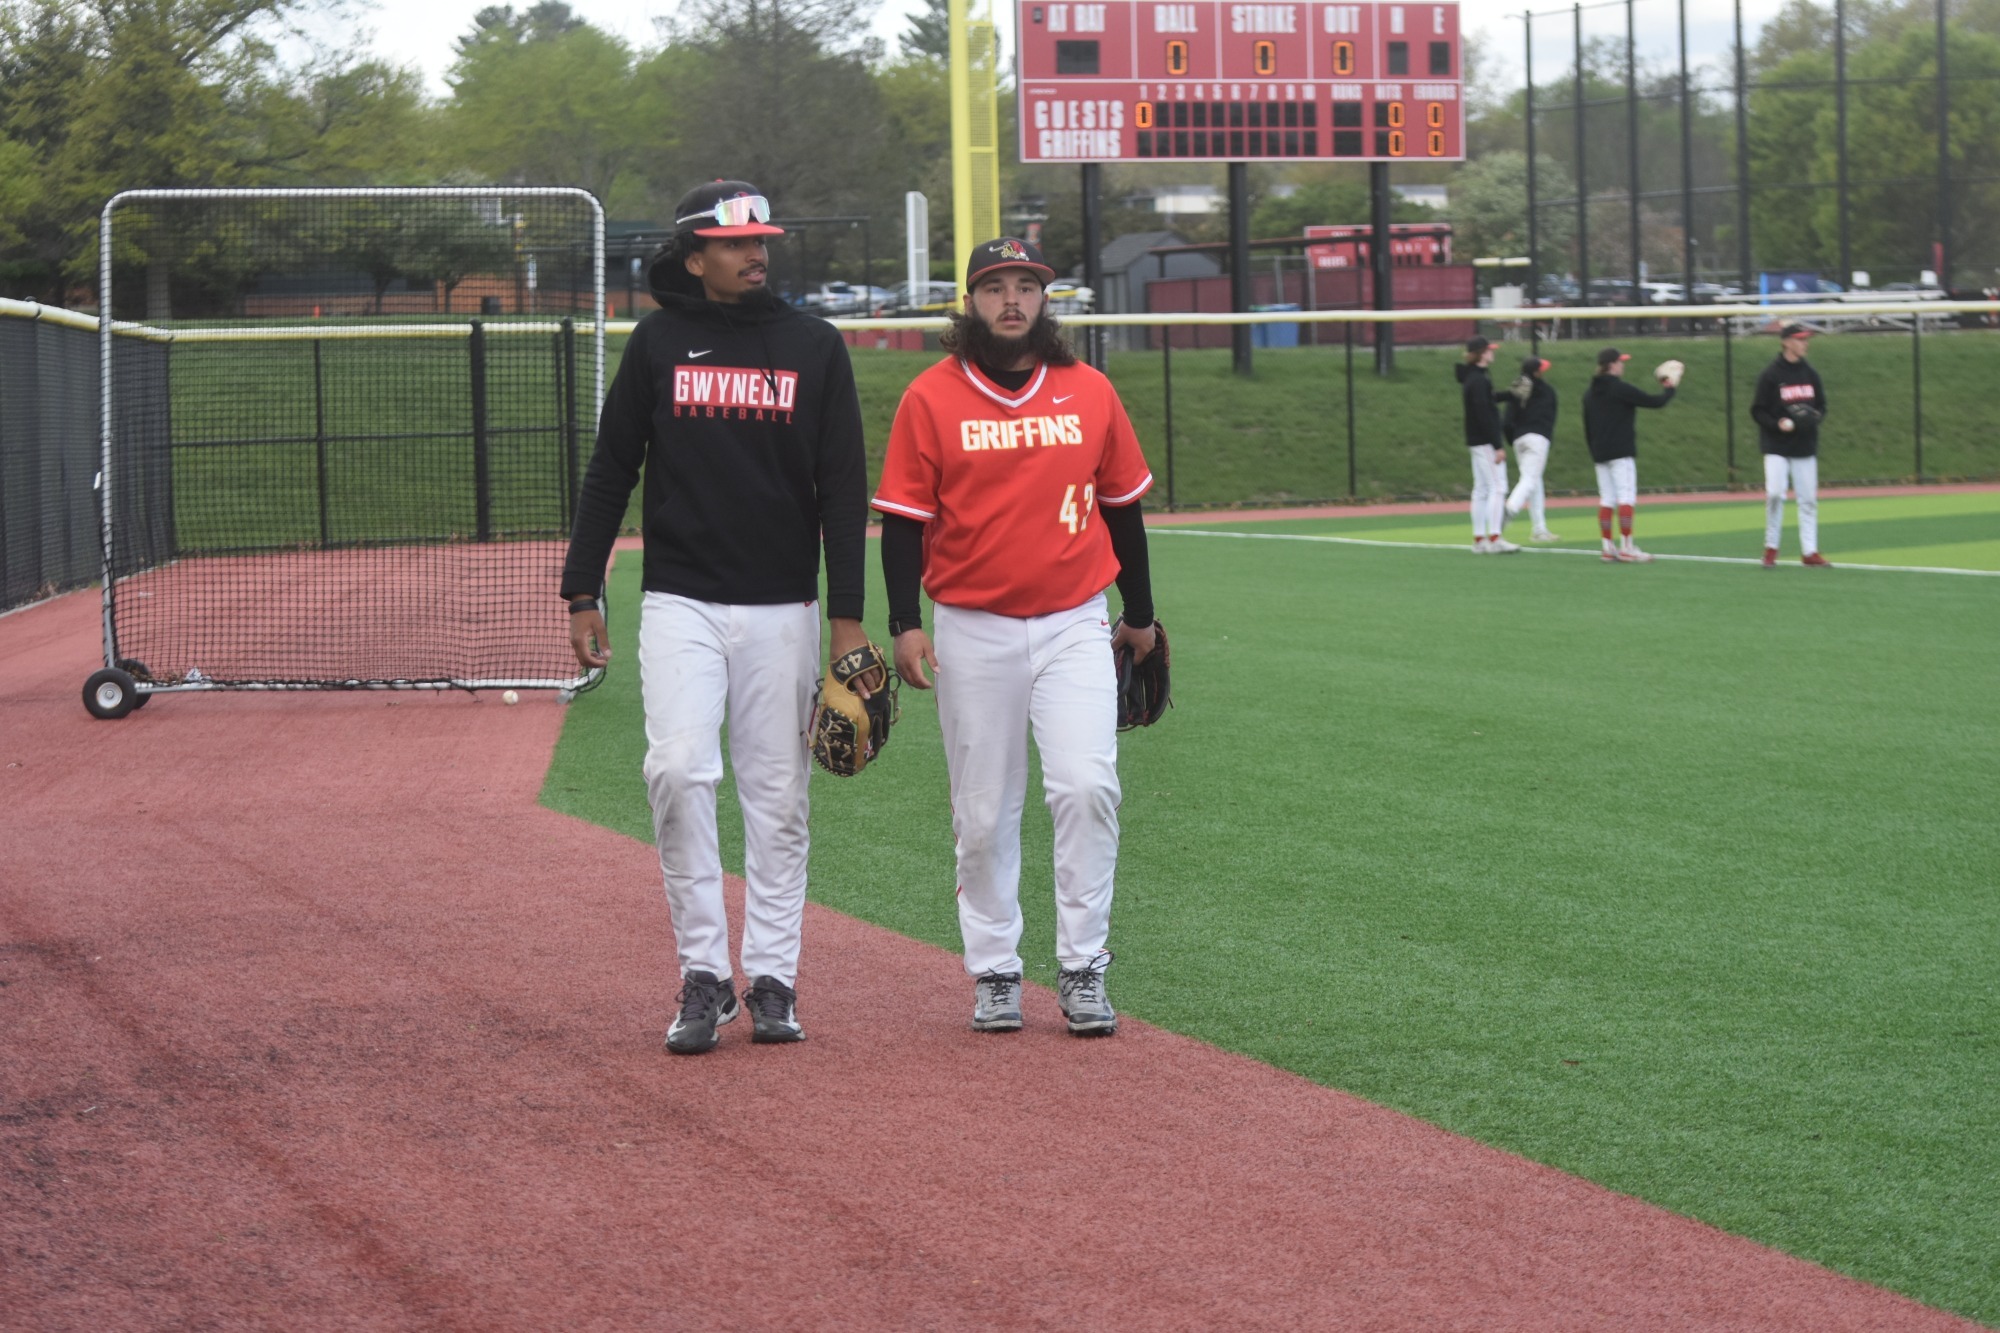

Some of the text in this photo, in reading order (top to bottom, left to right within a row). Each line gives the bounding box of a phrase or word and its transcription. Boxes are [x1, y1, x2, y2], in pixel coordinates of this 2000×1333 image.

[1047, 4, 1068, 32] AT
[1154, 4, 1198, 33] BALL
[1231, 5, 1297, 33] STRIKE
[1324, 5, 1361, 34] OUT
[1433, 6, 1445, 35] E
[1167, 40, 1188, 75] 0
[1254, 40, 1275, 75] 0
[1333, 40, 1354, 75] 0
[1139, 84, 1148, 100] 1
[1157, 84, 1167, 100] 2
[1175, 84, 1186, 100] 3
[1194, 84, 1204, 100] 4
[1212, 84, 1222, 100] 5
[1231, 84, 1241, 100] 6
[1248, 84, 1259, 100] 7
[1034, 100, 1124, 129] GUESTS
[1135, 102, 1152, 128] 0
[1388, 102, 1405, 128] 0
[1427, 102, 1444, 128] 0
[1038, 129, 1121, 158] GRIFFINS
[1388, 130, 1406, 156] 0
[1428, 130, 1445, 156] 0
[675, 370, 796, 408] GWYNEDD
[673, 406, 792, 424] BASEBALL
[960, 414, 1083, 451] GRIFFINS
